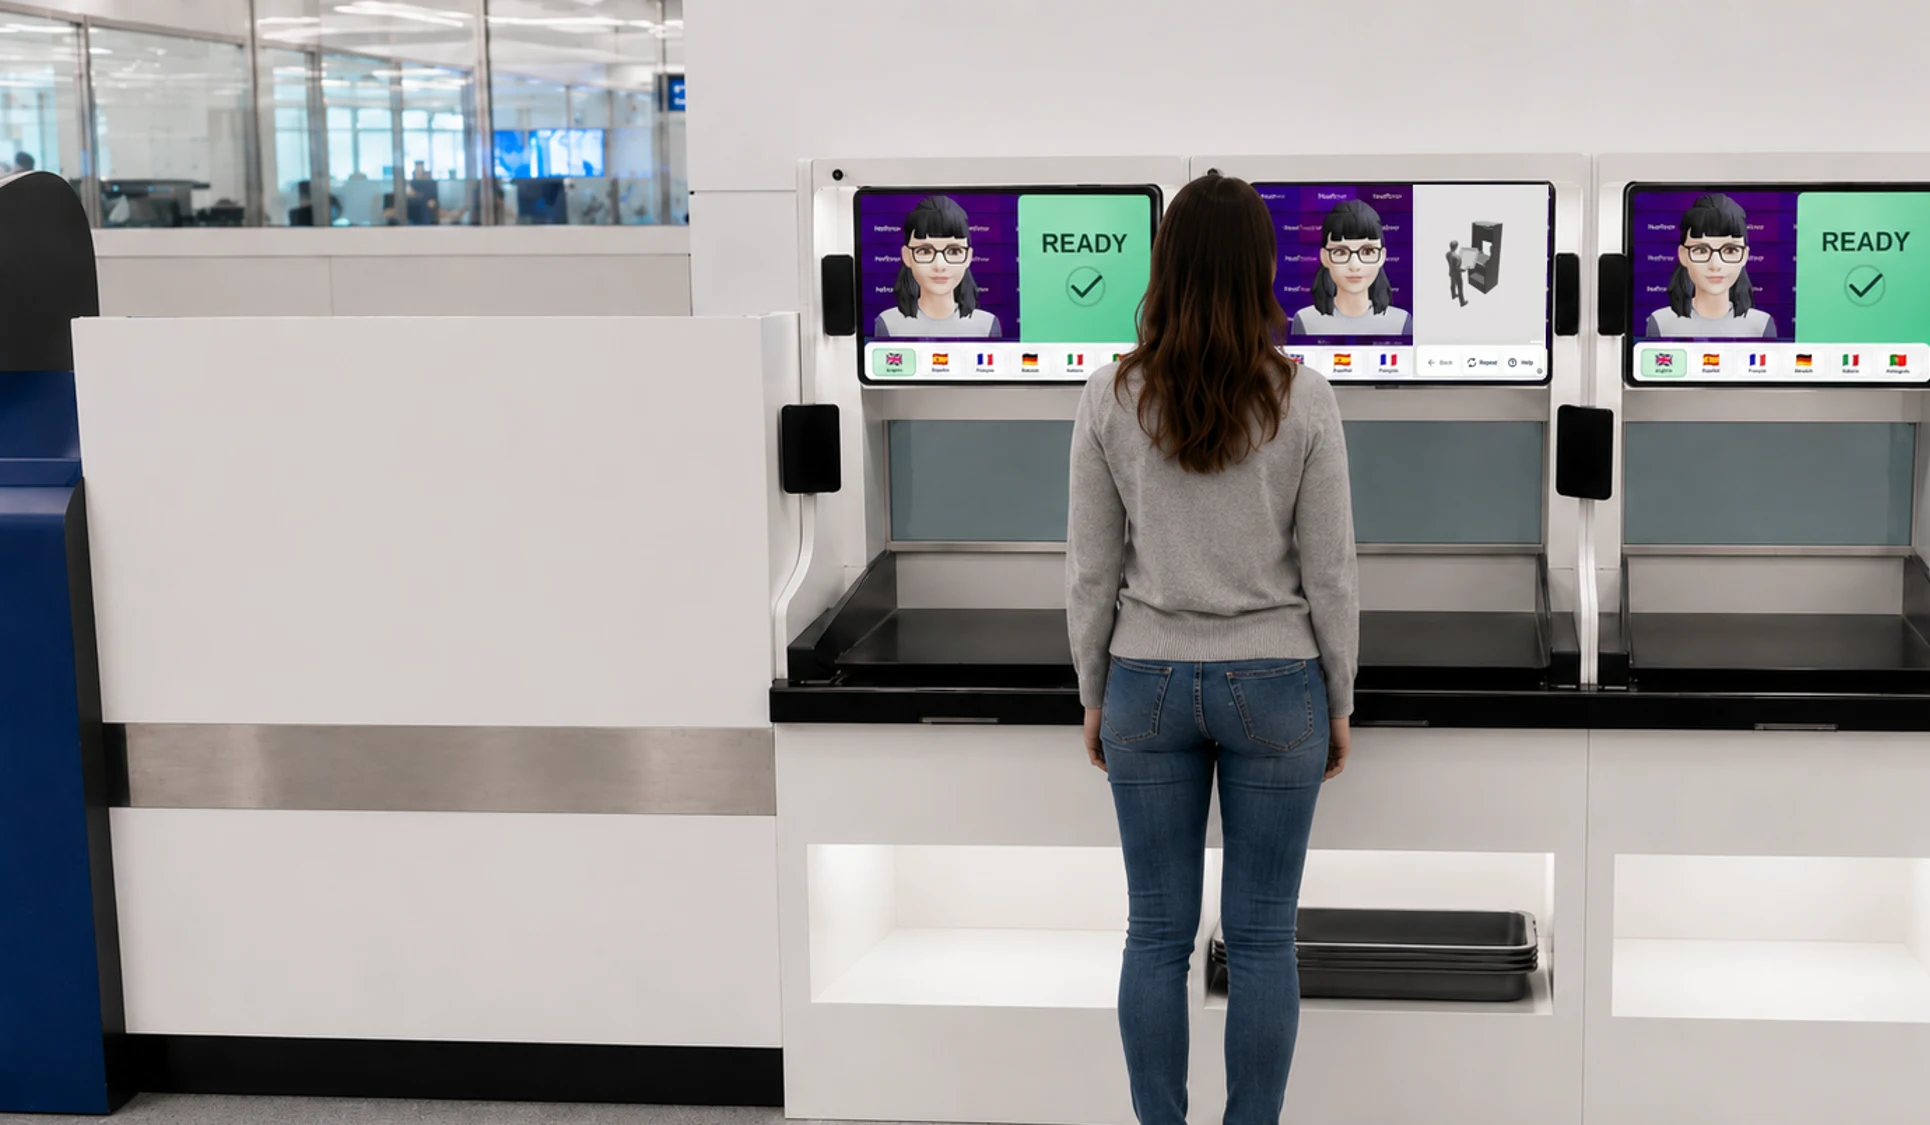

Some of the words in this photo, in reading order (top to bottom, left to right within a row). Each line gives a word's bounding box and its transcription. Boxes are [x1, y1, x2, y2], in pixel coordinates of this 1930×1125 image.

[1042, 233, 1128, 253] READY
[1822, 231, 1910, 252] READY
[1479, 359, 1498, 367] Repeat
[1521, 359, 1534, 367] Help
